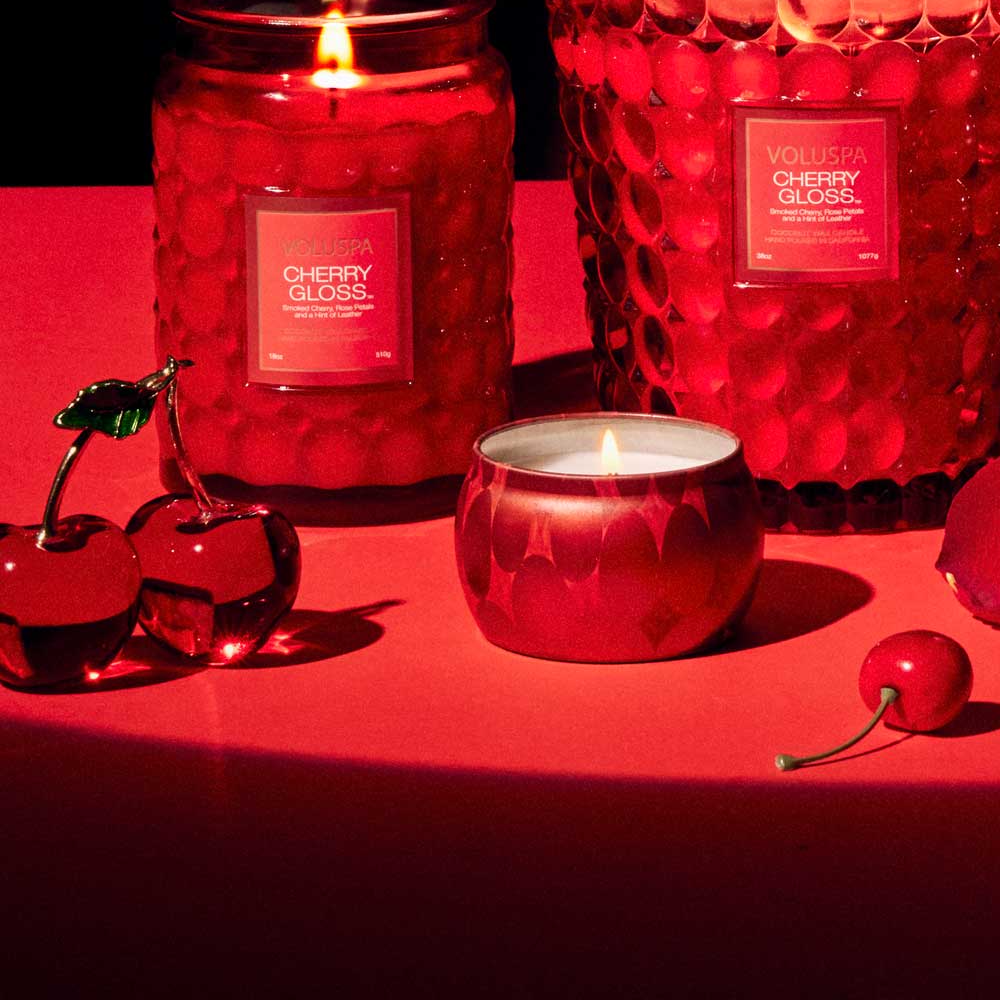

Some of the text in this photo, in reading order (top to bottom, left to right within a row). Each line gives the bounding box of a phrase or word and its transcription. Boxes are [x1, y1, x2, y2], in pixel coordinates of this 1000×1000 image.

[767, 146, 867, 165] VOLUSPA
[773, 170, 860, 187] CHERRY
[280, 237, 373, 256] VOLUSPA
[858, 252, 879, 260] 1077g
[283, 265, 372, 282] CHERRY
